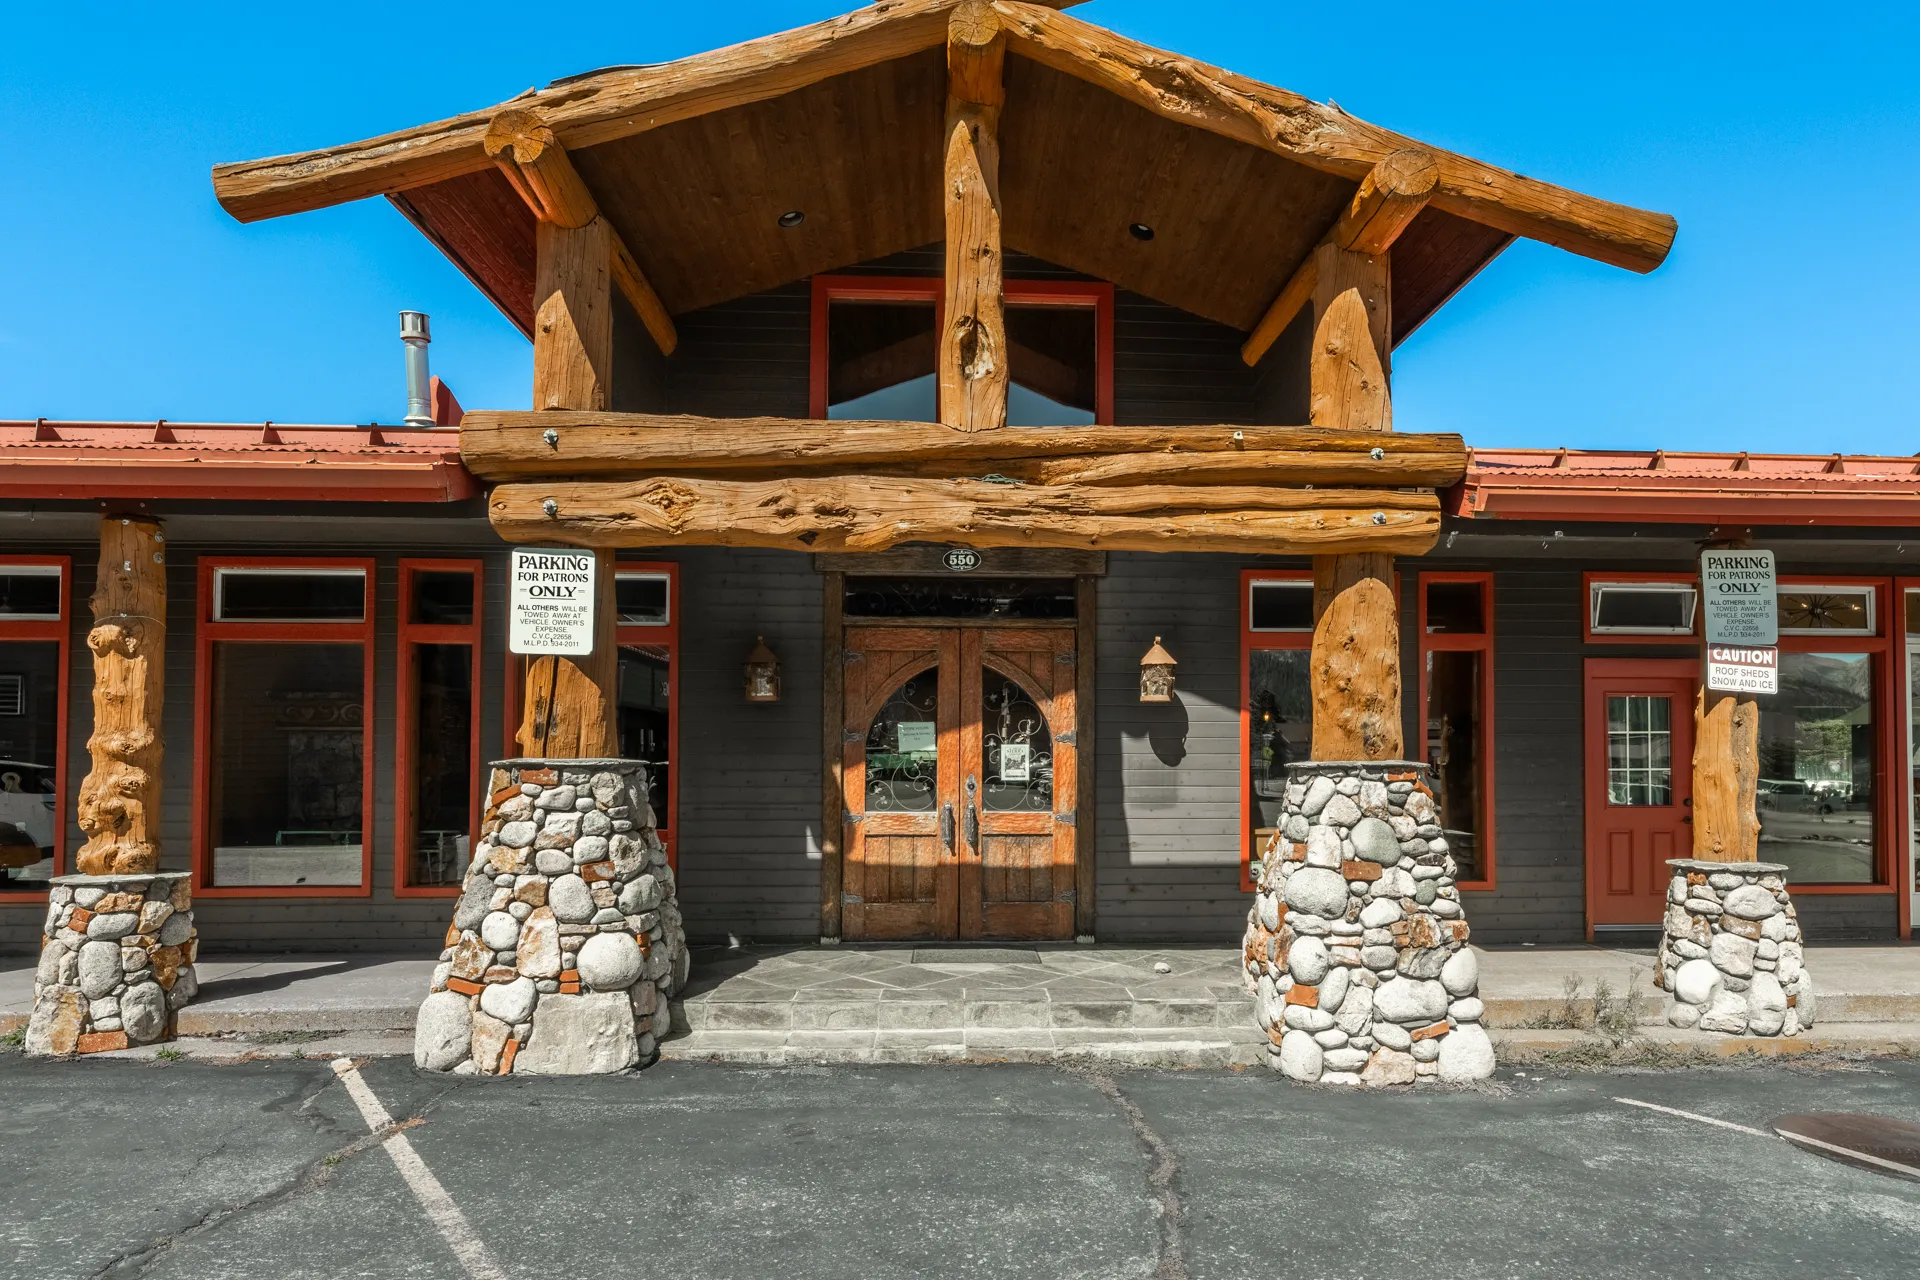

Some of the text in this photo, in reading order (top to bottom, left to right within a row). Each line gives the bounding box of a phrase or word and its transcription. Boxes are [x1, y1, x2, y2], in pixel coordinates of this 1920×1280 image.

[519, 555, 588, 570] PARKING
[949, 555, 974, 565] 550
[1708, 557, 1769, 569] PARKING
[518, 572, 588, 582] FOR PATRONS
[1708, 571, 1770, 580] FOR PATRONS
[529, 585, 576, 597] ONLY
[1719, 583, 1761, 593] ONLY
[1713, 648, 1773, 664] CAUTION
[1716, 667, 1769, 678] ROOF SHEDS
[1712, 677, 1773, 689] SNOW AND ICE
